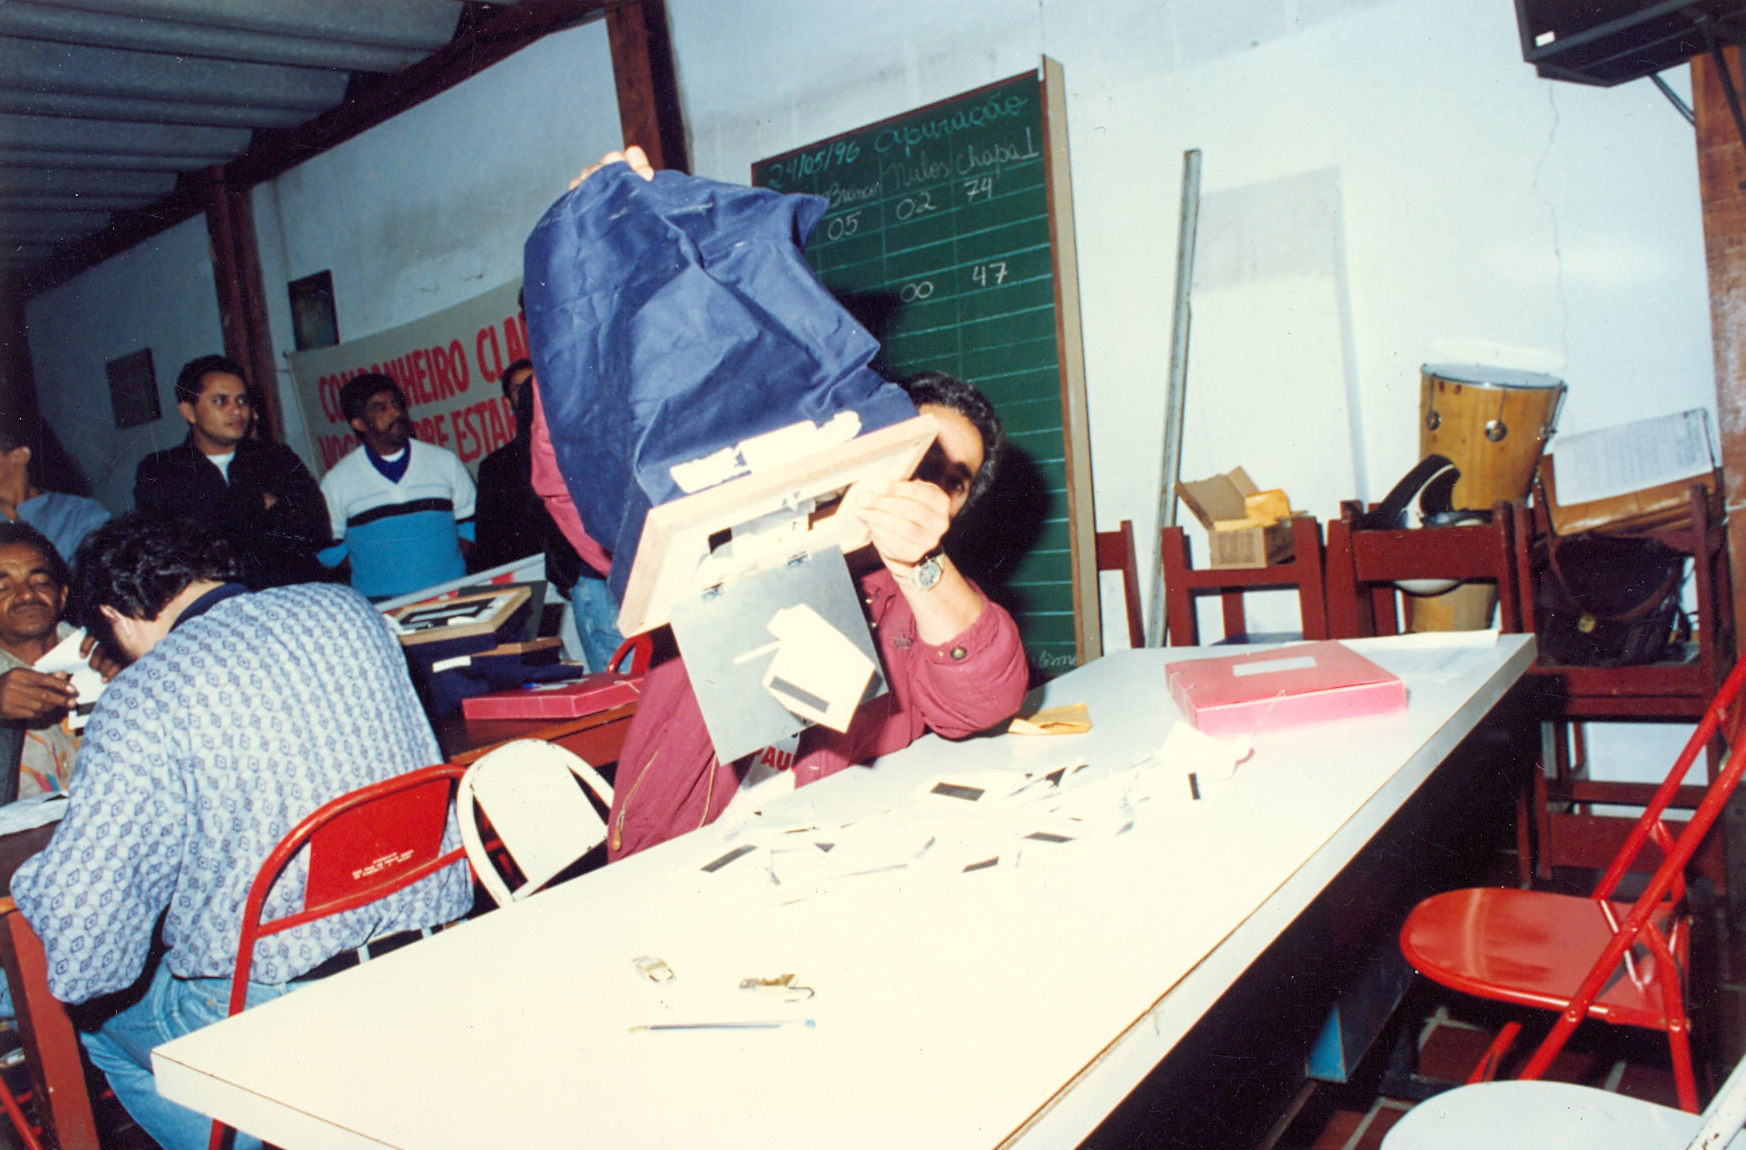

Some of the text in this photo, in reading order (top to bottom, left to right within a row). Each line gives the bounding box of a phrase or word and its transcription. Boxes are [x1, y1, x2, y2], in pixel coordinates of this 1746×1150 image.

[828, 177, 993, 240] 05 02 74
[900, 262, 1008, 303] 00 47
